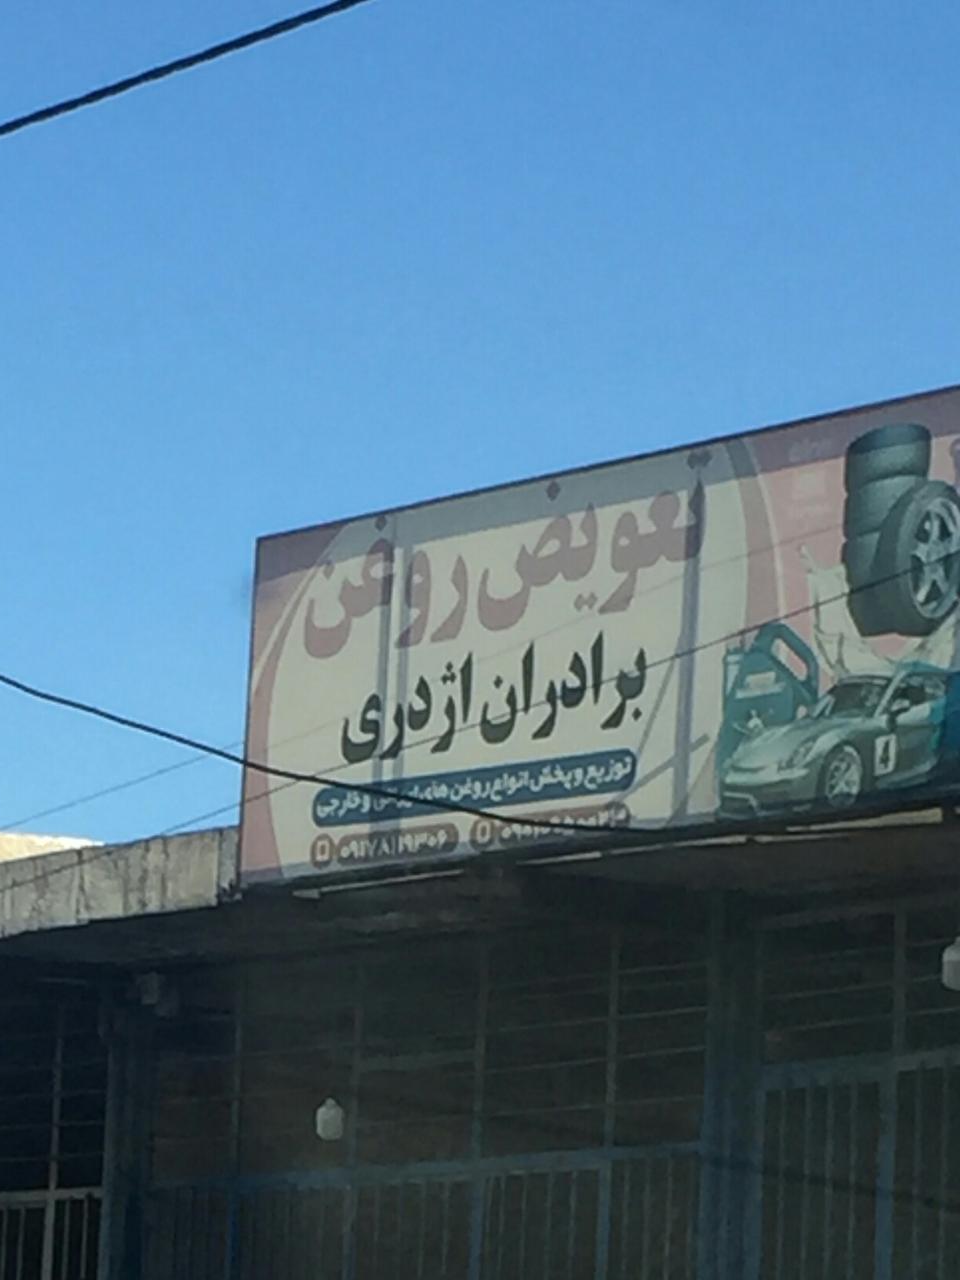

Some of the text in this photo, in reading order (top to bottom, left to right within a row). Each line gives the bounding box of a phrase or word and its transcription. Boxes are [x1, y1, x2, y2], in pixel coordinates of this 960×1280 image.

[304, 448, 711, 658] تعویض روغن
[341, 630, 648, 764] برادران اژدری
